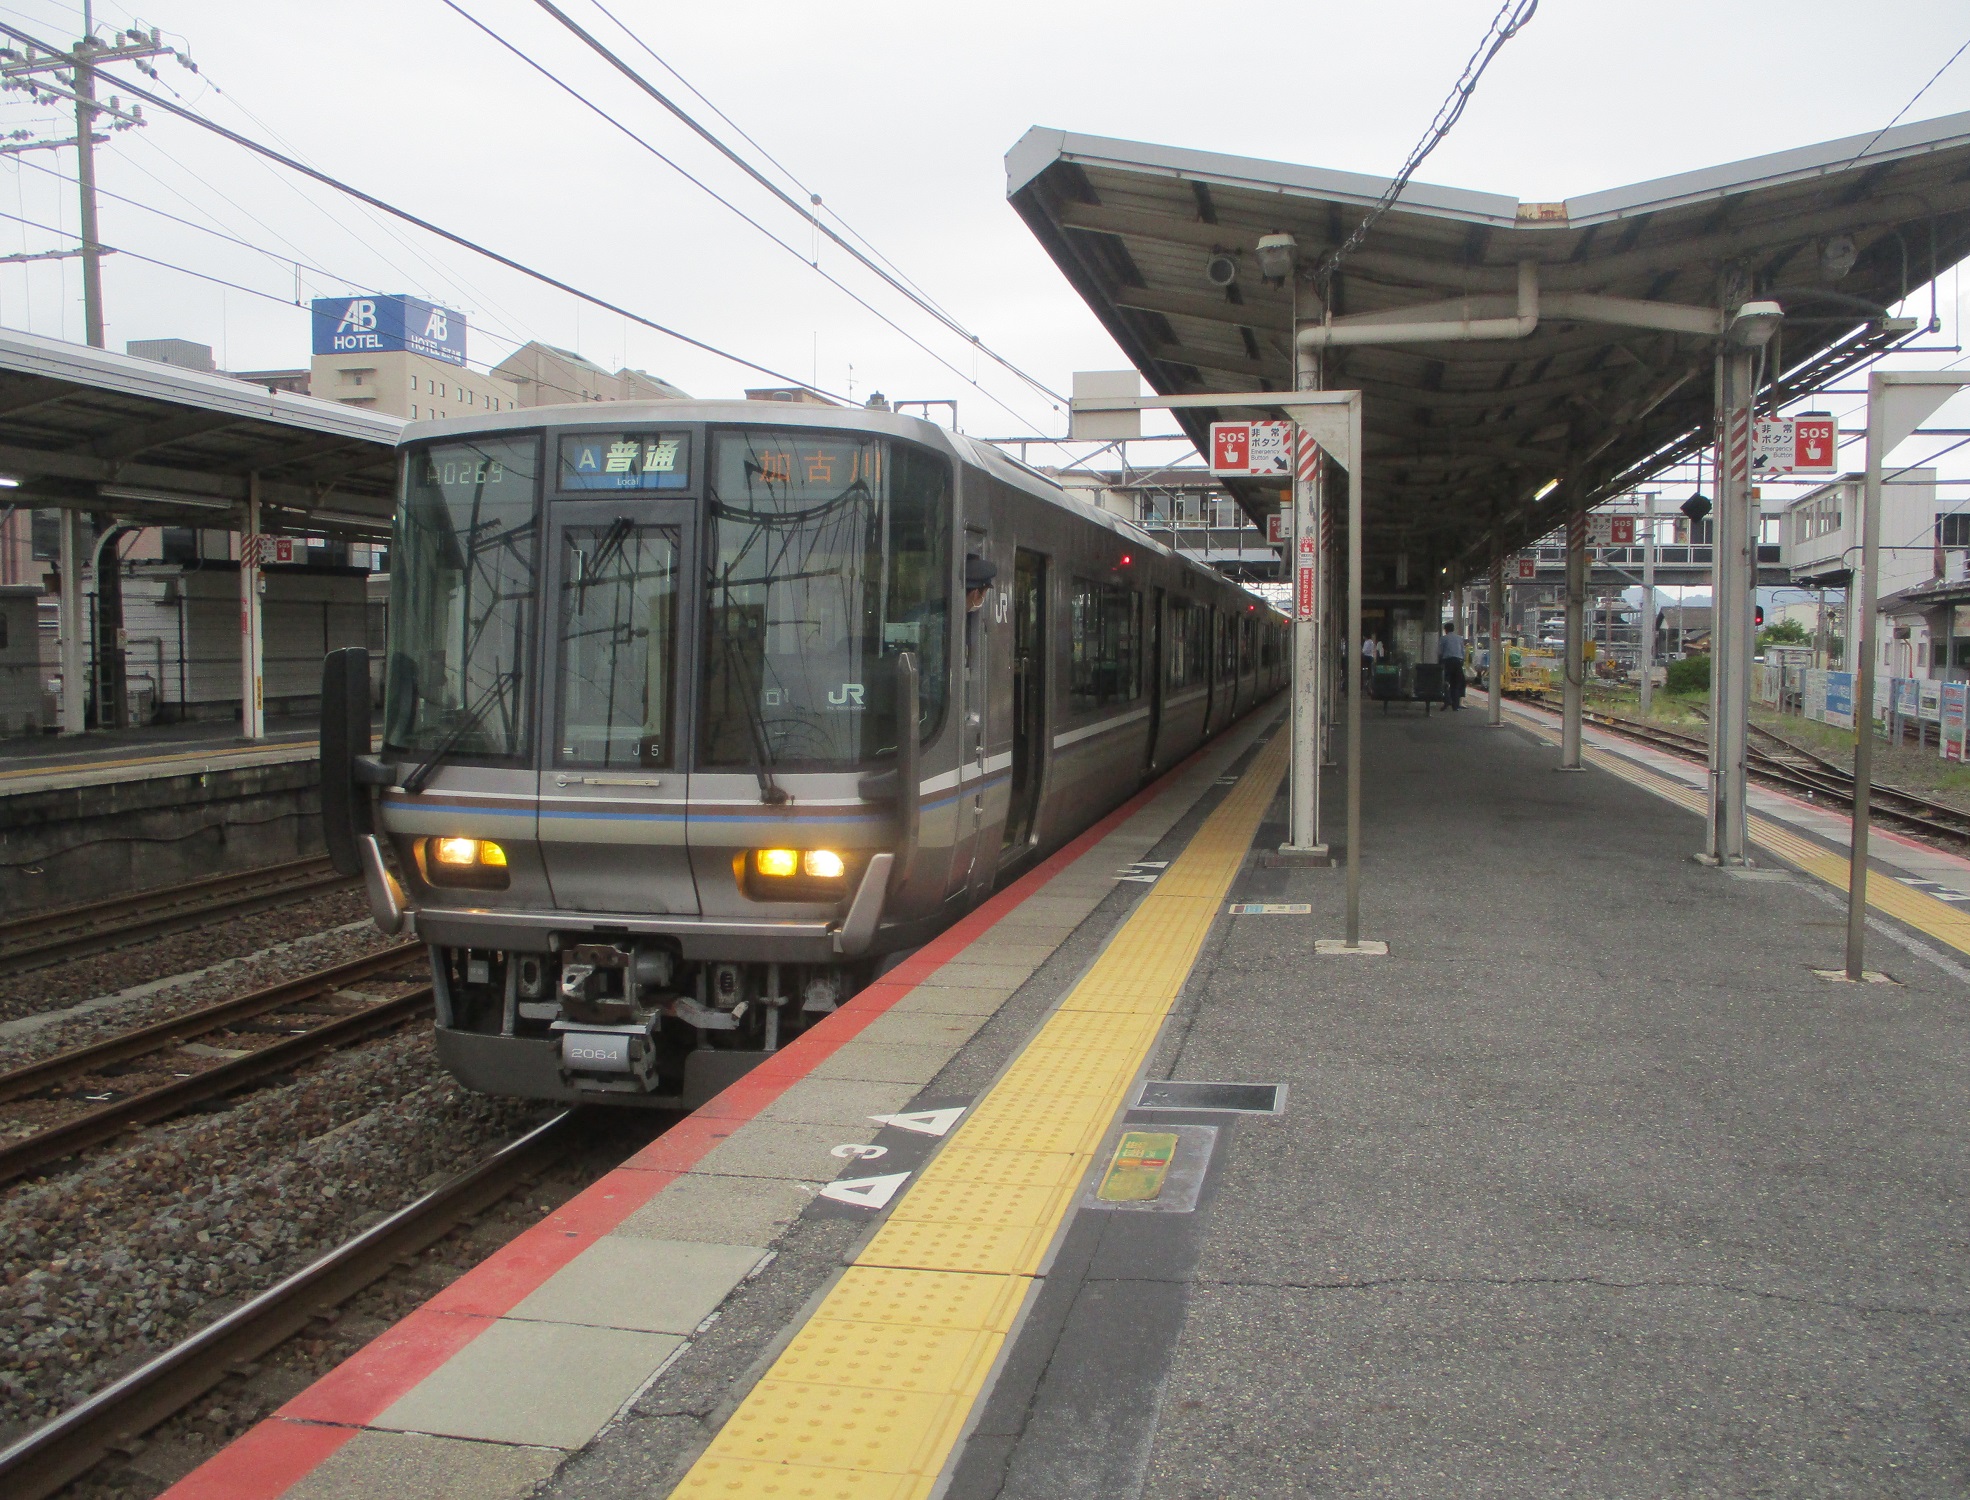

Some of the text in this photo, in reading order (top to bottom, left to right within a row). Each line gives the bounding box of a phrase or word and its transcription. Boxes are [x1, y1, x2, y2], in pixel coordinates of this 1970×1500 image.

[337, 300, 377, 333] AB
[425, 307, 448, 341] AB
[334, 334, 383, 349] HOTEL
[411, 335, 440, 356] HOTEL
[1218, 432, 1245, 443] SOS
[1762, 434, 1793, 444] ボタン
[1799, 427, 1829, 439] SOS
[1251, 438, 1280, 447] ボタン
[579, 440, 680, 472] A 普通
[758, 450, 881, 483] 加古川
[617, 478, 639, 486] Local
[995, 592, 1008, 624] JR
[828, 683, 865, 705] JR
[571, 1048, 618, 1060] 2064
